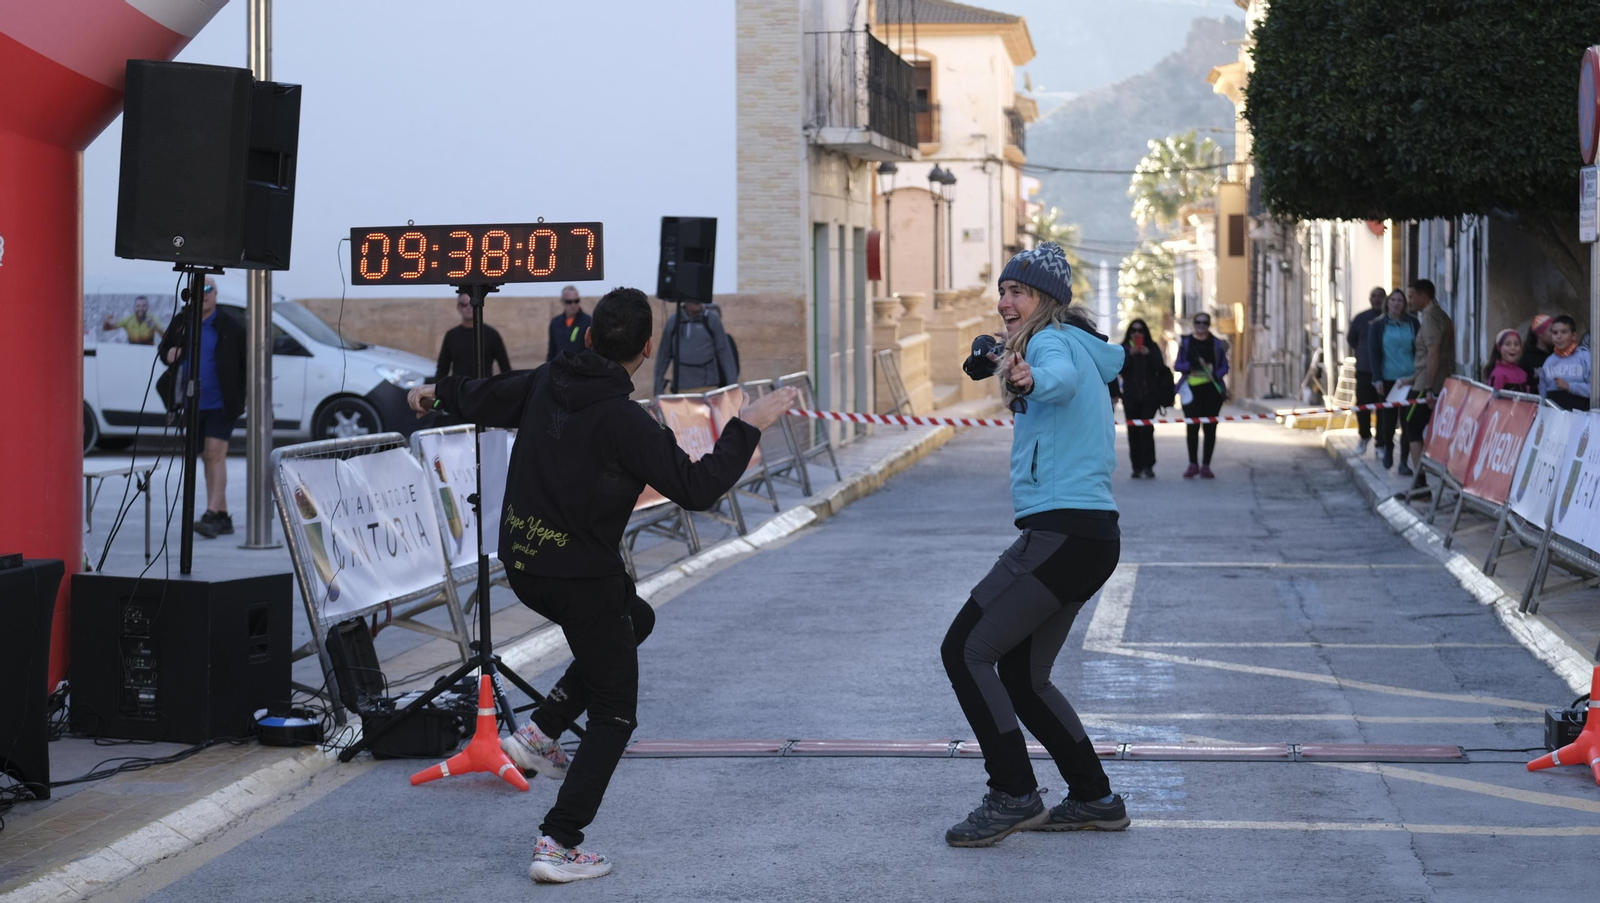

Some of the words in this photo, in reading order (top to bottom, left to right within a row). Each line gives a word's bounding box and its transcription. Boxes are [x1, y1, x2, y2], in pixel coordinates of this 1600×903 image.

[359, 228, 595, 280] 09:38:07
[321, 488, 402, 518] AYUNTAMENTO
[504, 504, 525, 534] Pepe
[526, 515, 570, 547] Yepes
